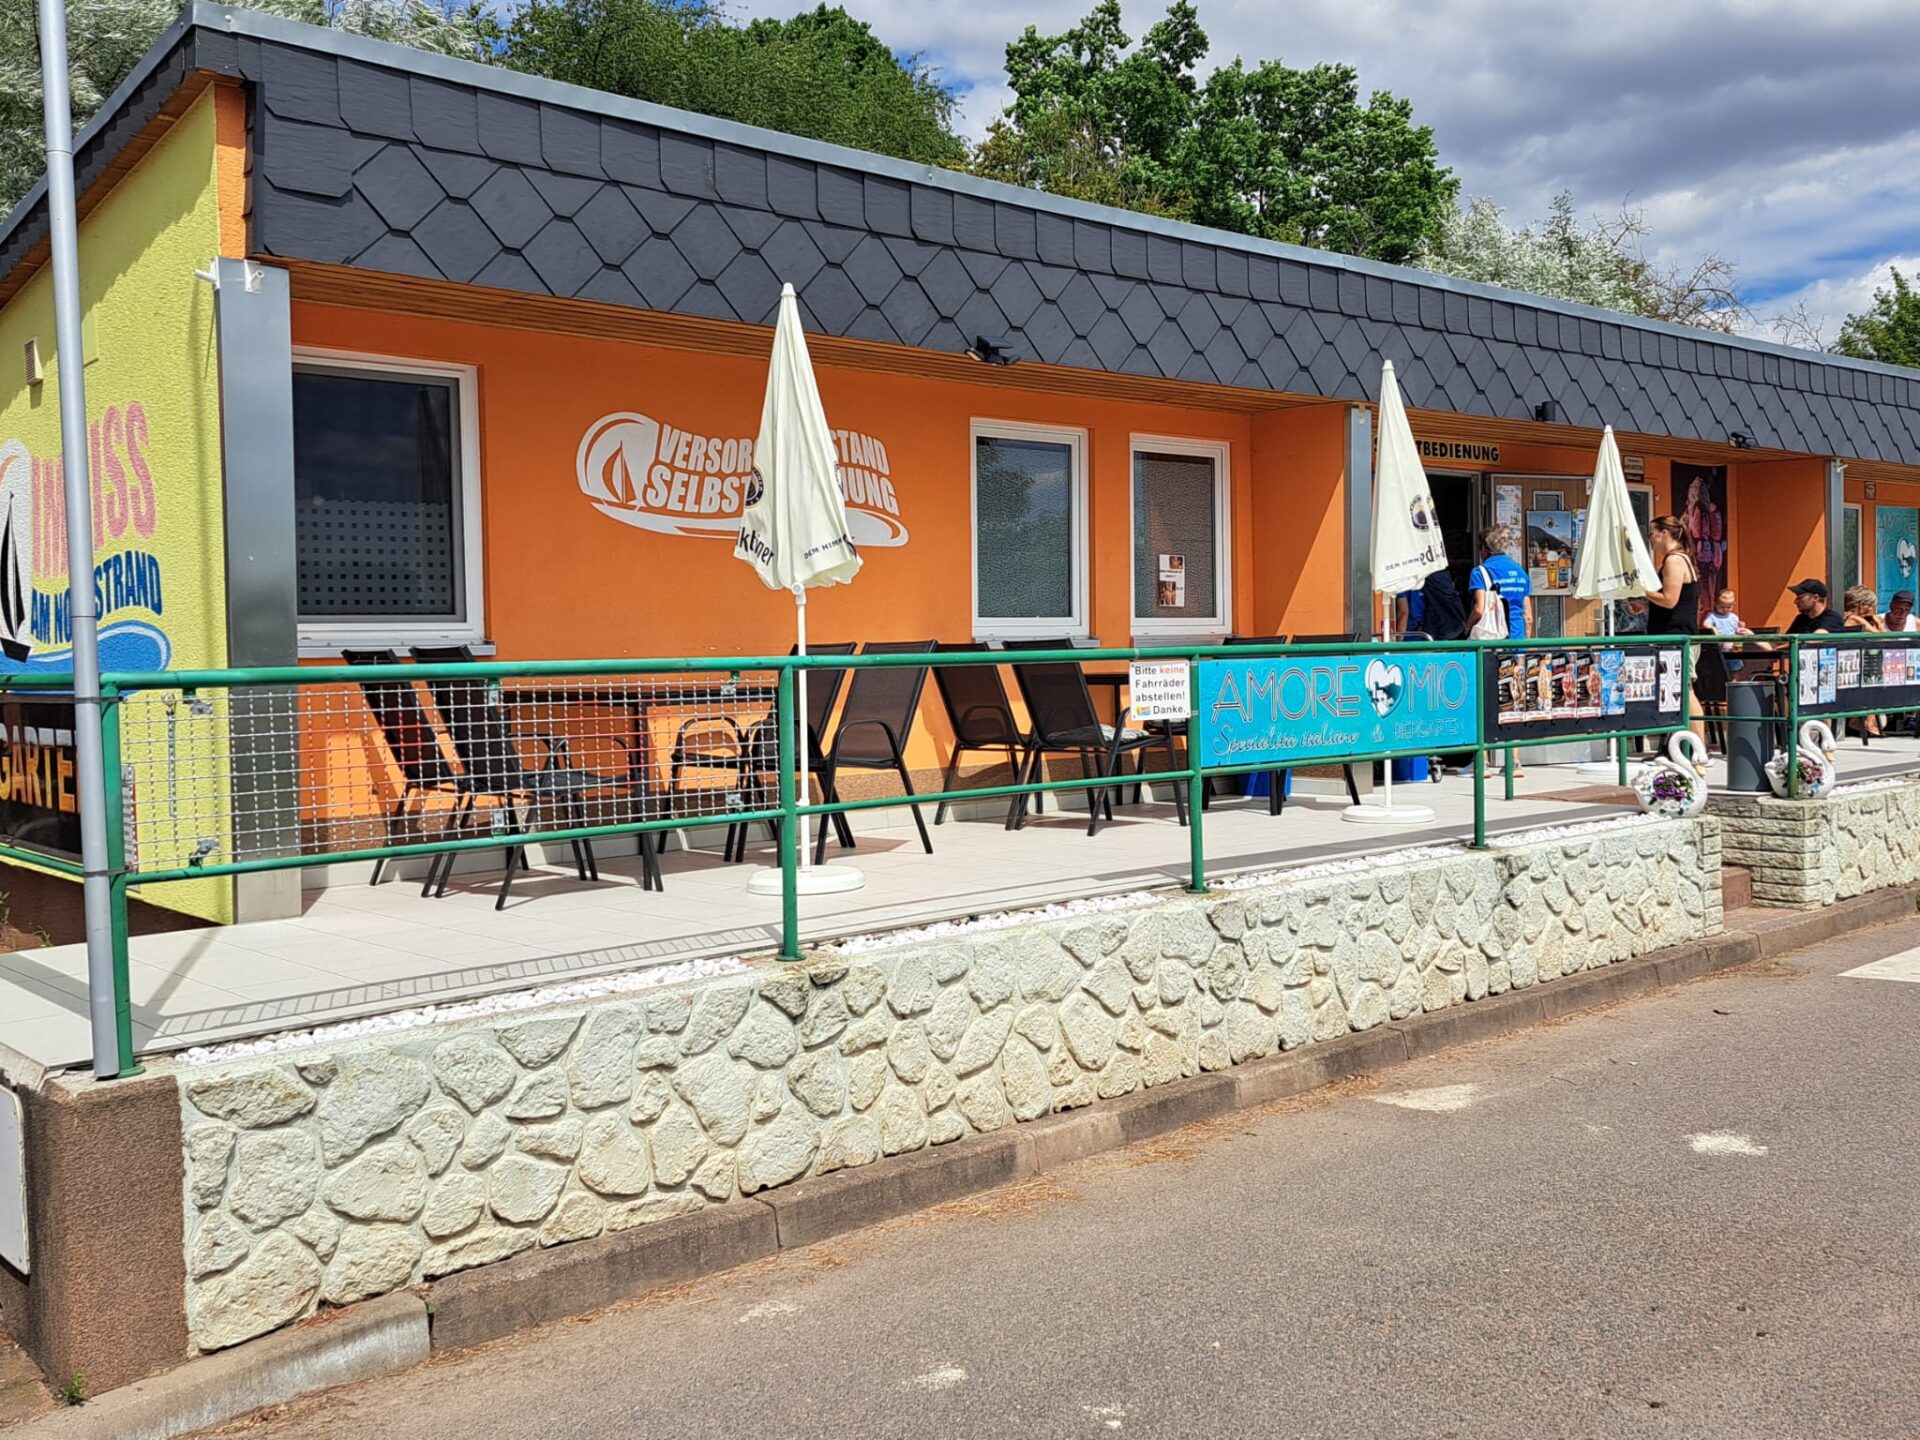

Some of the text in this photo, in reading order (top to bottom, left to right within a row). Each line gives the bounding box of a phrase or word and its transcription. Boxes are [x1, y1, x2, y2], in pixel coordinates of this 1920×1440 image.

[31, 400, 157, 579] IMISS
[31, 585, 51, 644] AM
[1135, 664, 1184, 675] Bitte keine
[1135, 678, 1185, 689] Fahrräder
[1211, 661, 1468, 725] AMORE MIO
[1135, 692, 1185, 702] abstellen!
[1153, 705, 1186, 715] Danke.
[1372, 723, 1385, 743] &
[0, 722, 80, 814] GARTE
